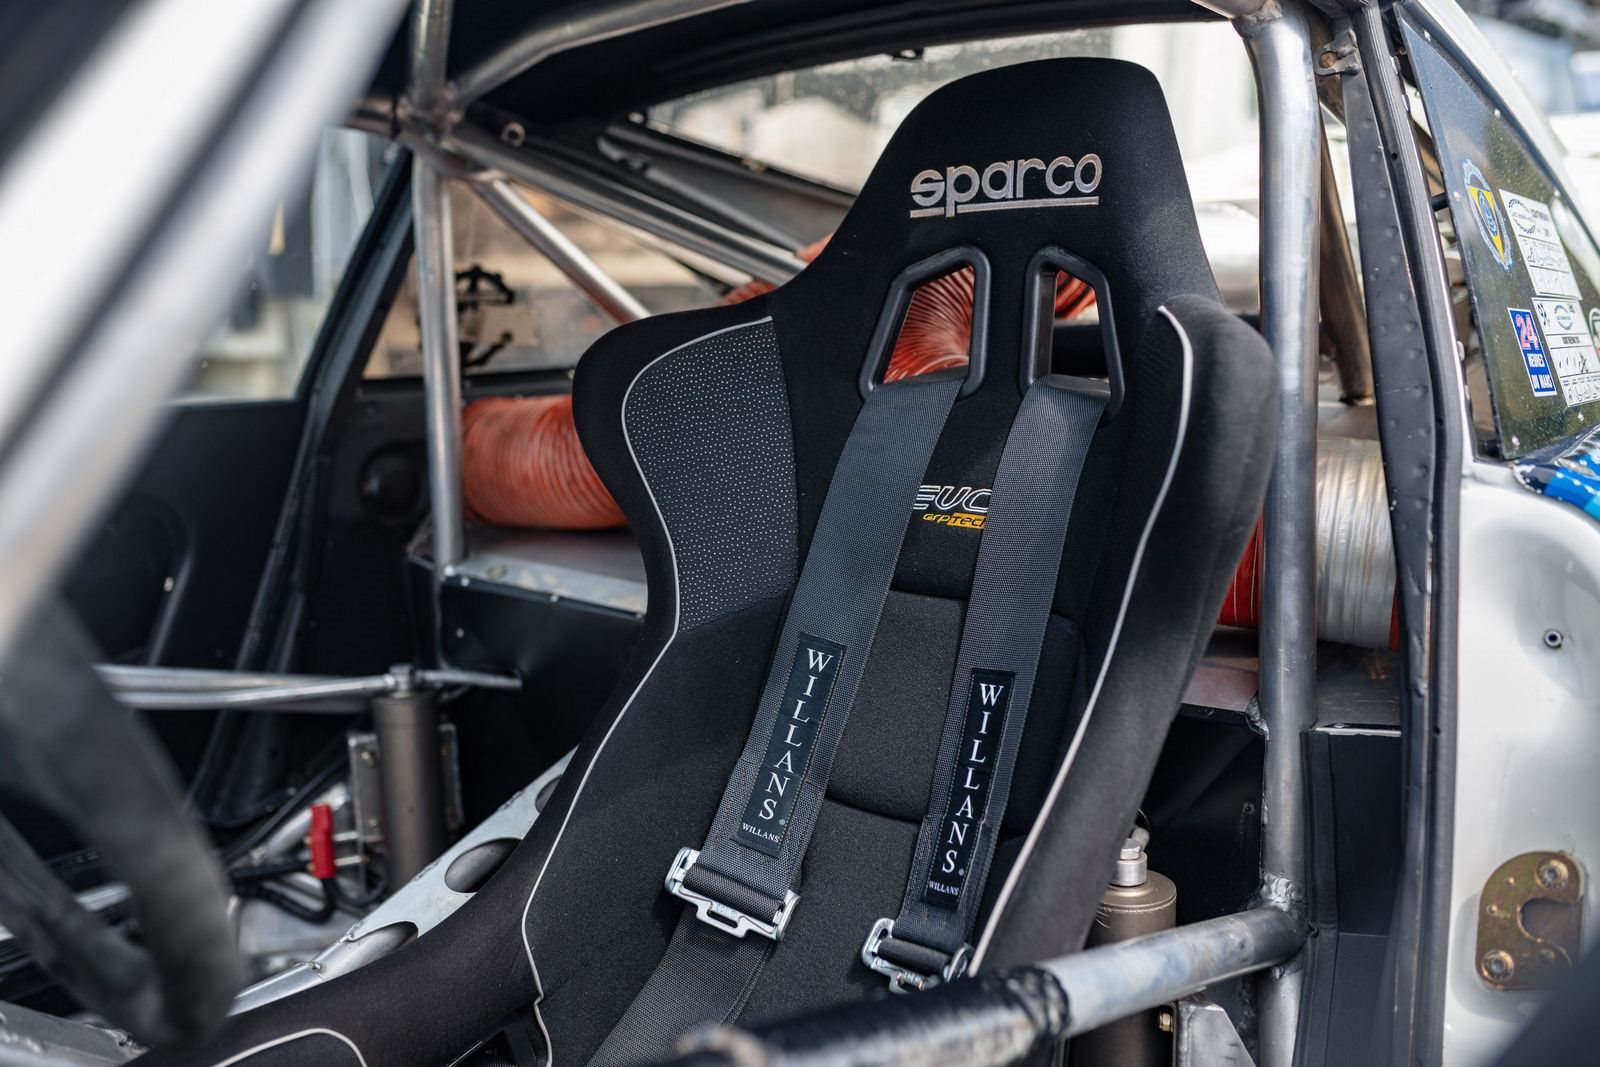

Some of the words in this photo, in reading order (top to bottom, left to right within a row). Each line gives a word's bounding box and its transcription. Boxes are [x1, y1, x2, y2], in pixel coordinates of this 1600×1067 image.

[910, 153, 1103, 218] sparco
[1515, 314, 1540, 350] 24
[742, 822, 780, 843] WILLANS
[929, 880, 960, 896] WILLANS
